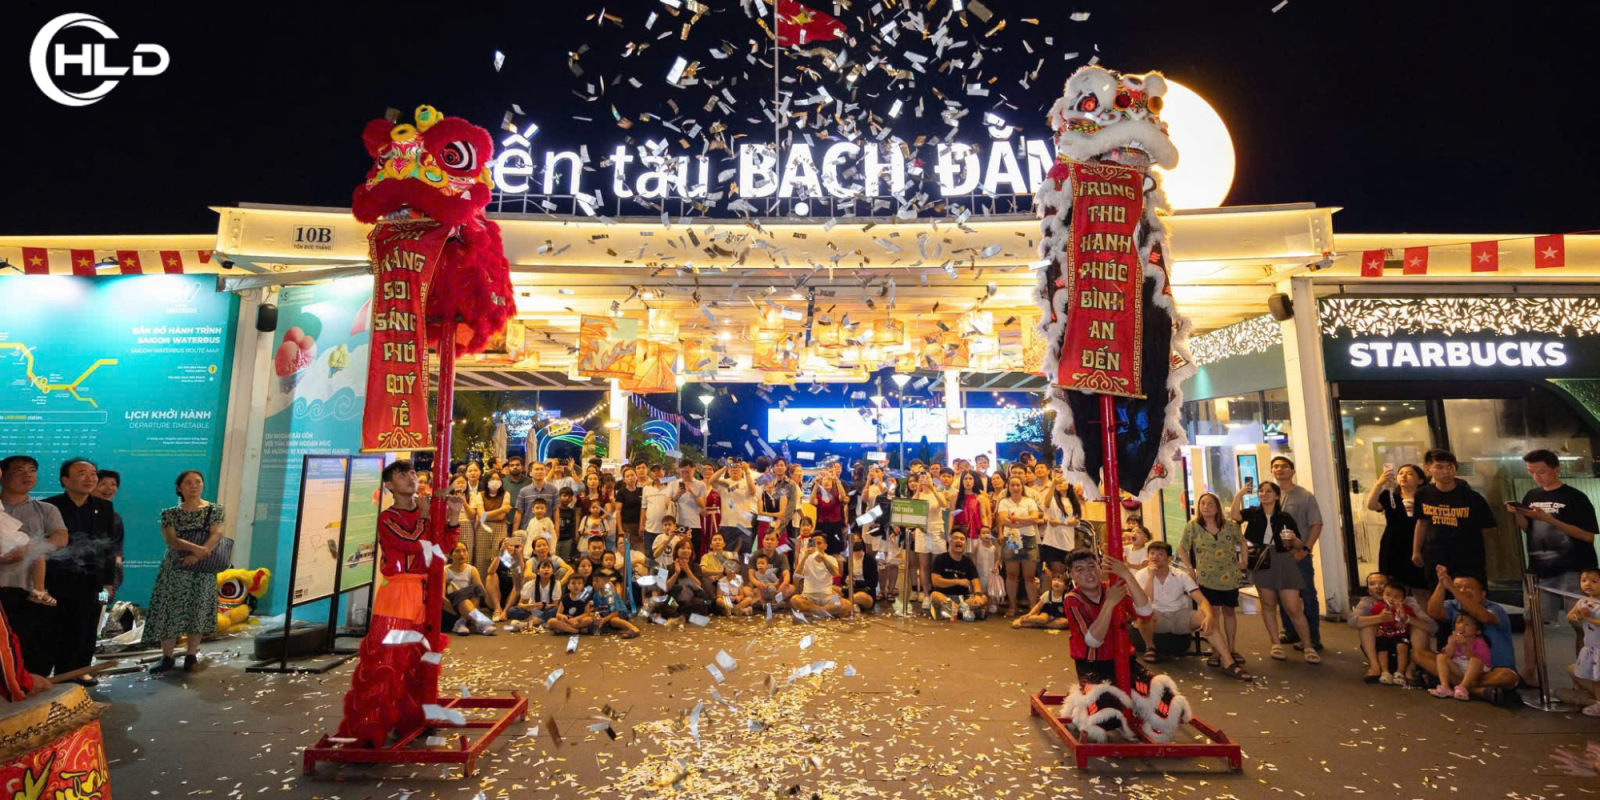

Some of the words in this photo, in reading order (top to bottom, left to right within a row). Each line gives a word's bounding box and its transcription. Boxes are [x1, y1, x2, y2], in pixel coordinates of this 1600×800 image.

[494, 123, 581, 194] ến
[739, 142, 905, 216] BẠCH
[935, 113, 1058, 194] ĐẰN
[1079, 181, 1135, 200] TRUNG
[1088, 205, 1126, 223] THU
[295, 227, 331, 242] 10B
[1080, 233, 1132, 254] HẠNH
[1079, 259, 1128, 282] PHÚC
[1080, 286, 1125, 311] BÌNH
[137, 336, 171, 344] SAIGON
[172, 336, 221, 344] WATERBUS
[1088, 320, 1115, 340] AN
[1081, 345, 1120, 371] ĐẾN
[1349, 341, 1568, 368] STARBUCKS
[386, 371, 417, 396] QUÝ
[125, 410, 149, 421] LỊCH
[151, 408, 178, 419] KHỞI
[180, 408, 212, 419] HÀNH
